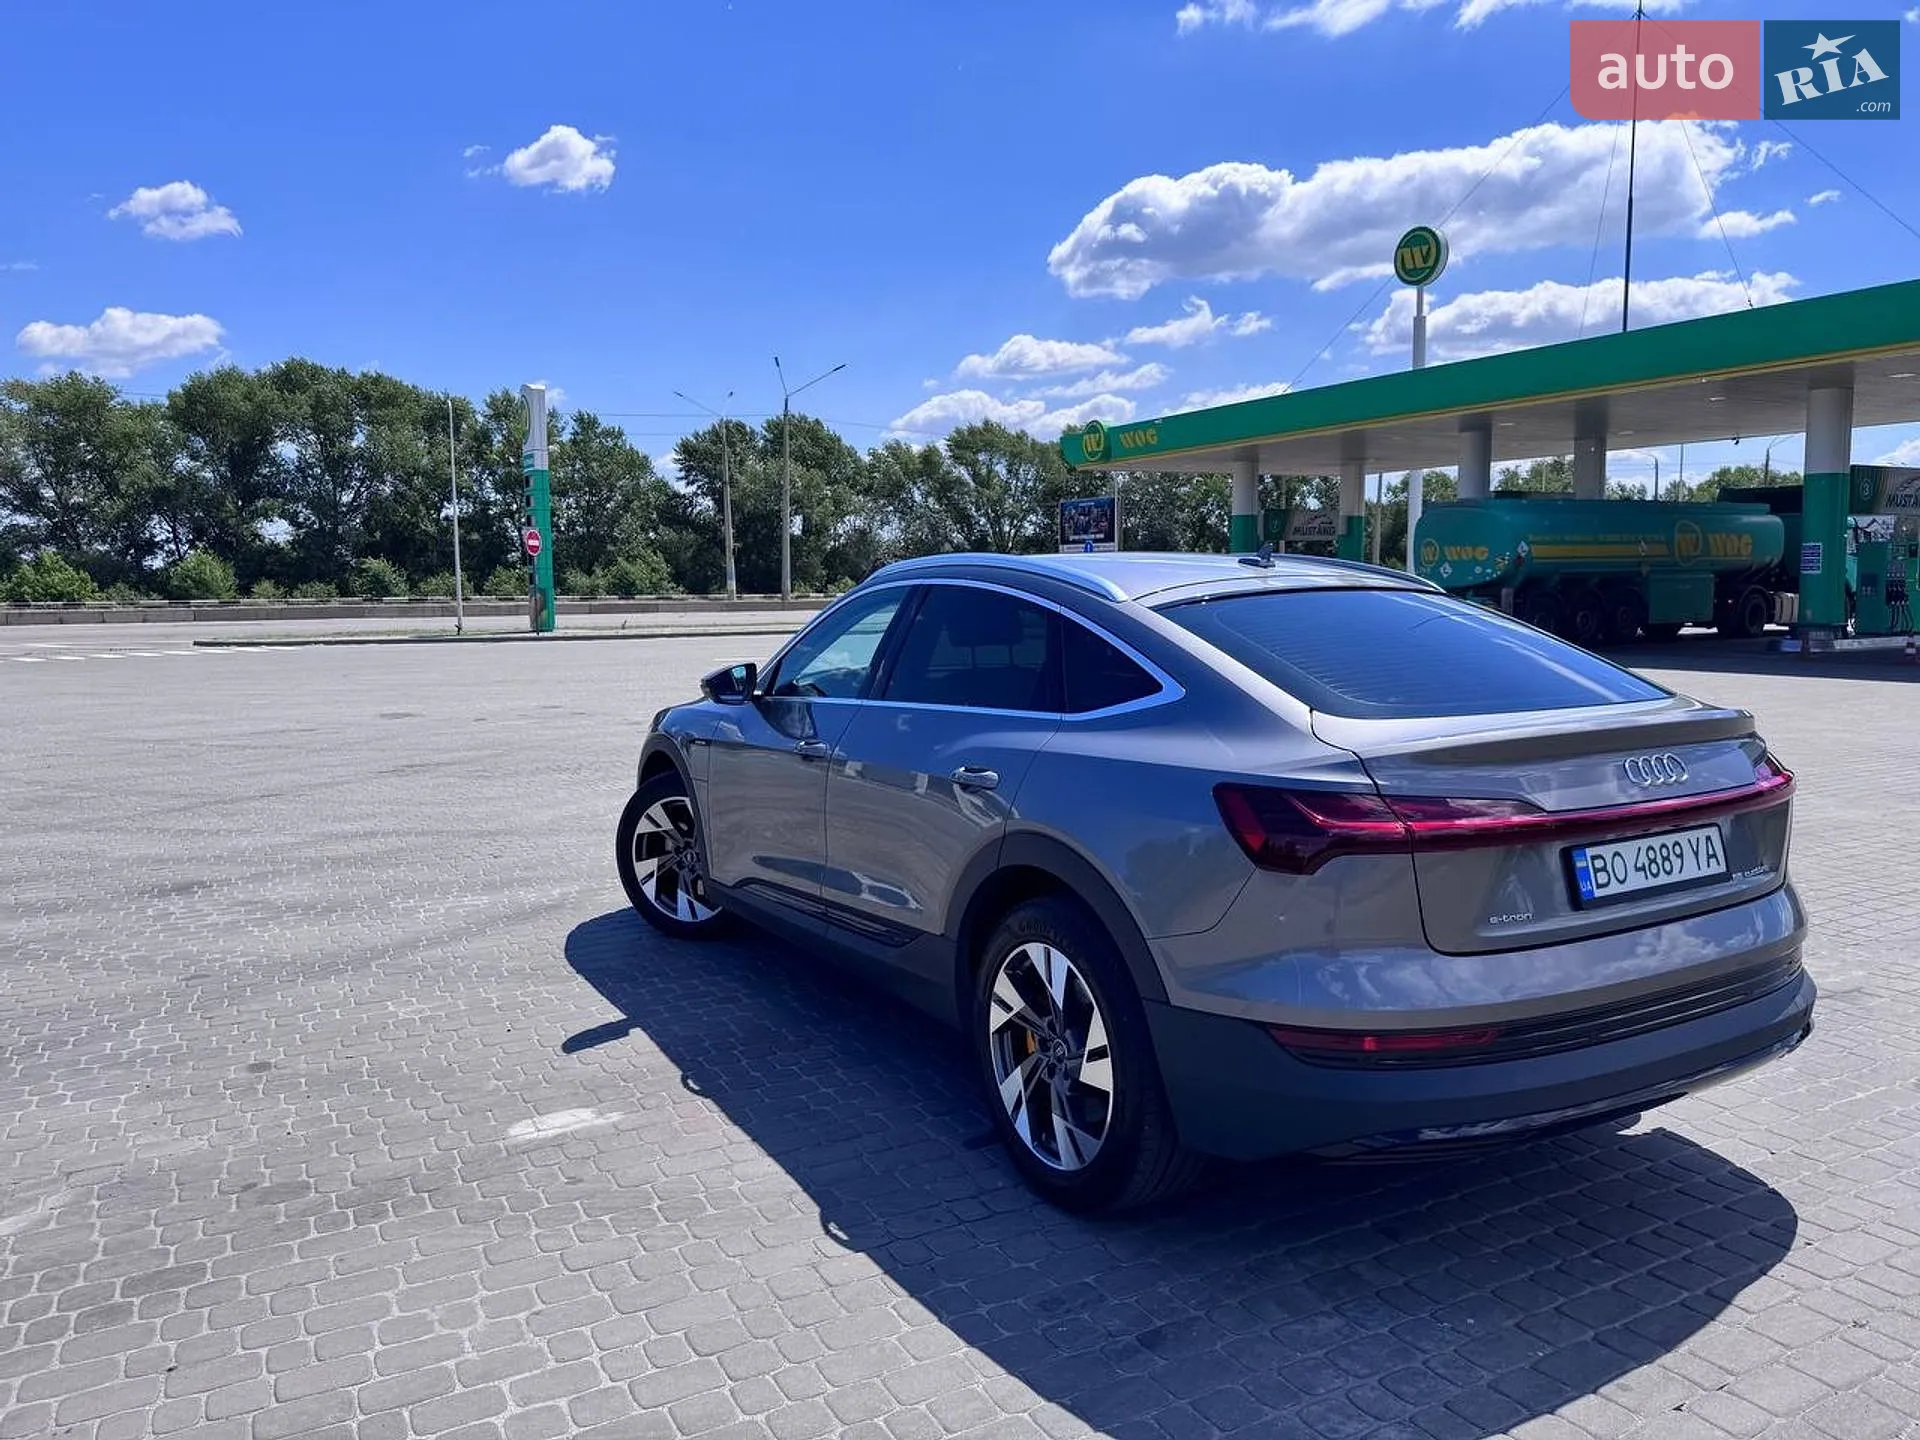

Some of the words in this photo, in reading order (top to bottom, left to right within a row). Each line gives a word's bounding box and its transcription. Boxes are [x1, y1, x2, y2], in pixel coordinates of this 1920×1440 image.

[1590, 850, 1628, 889] BO
[1634, 840, 1685, 881] 4889
[1687, 835, 1721, 872] YA
[1490, 913, 1533, 924] e-tron
